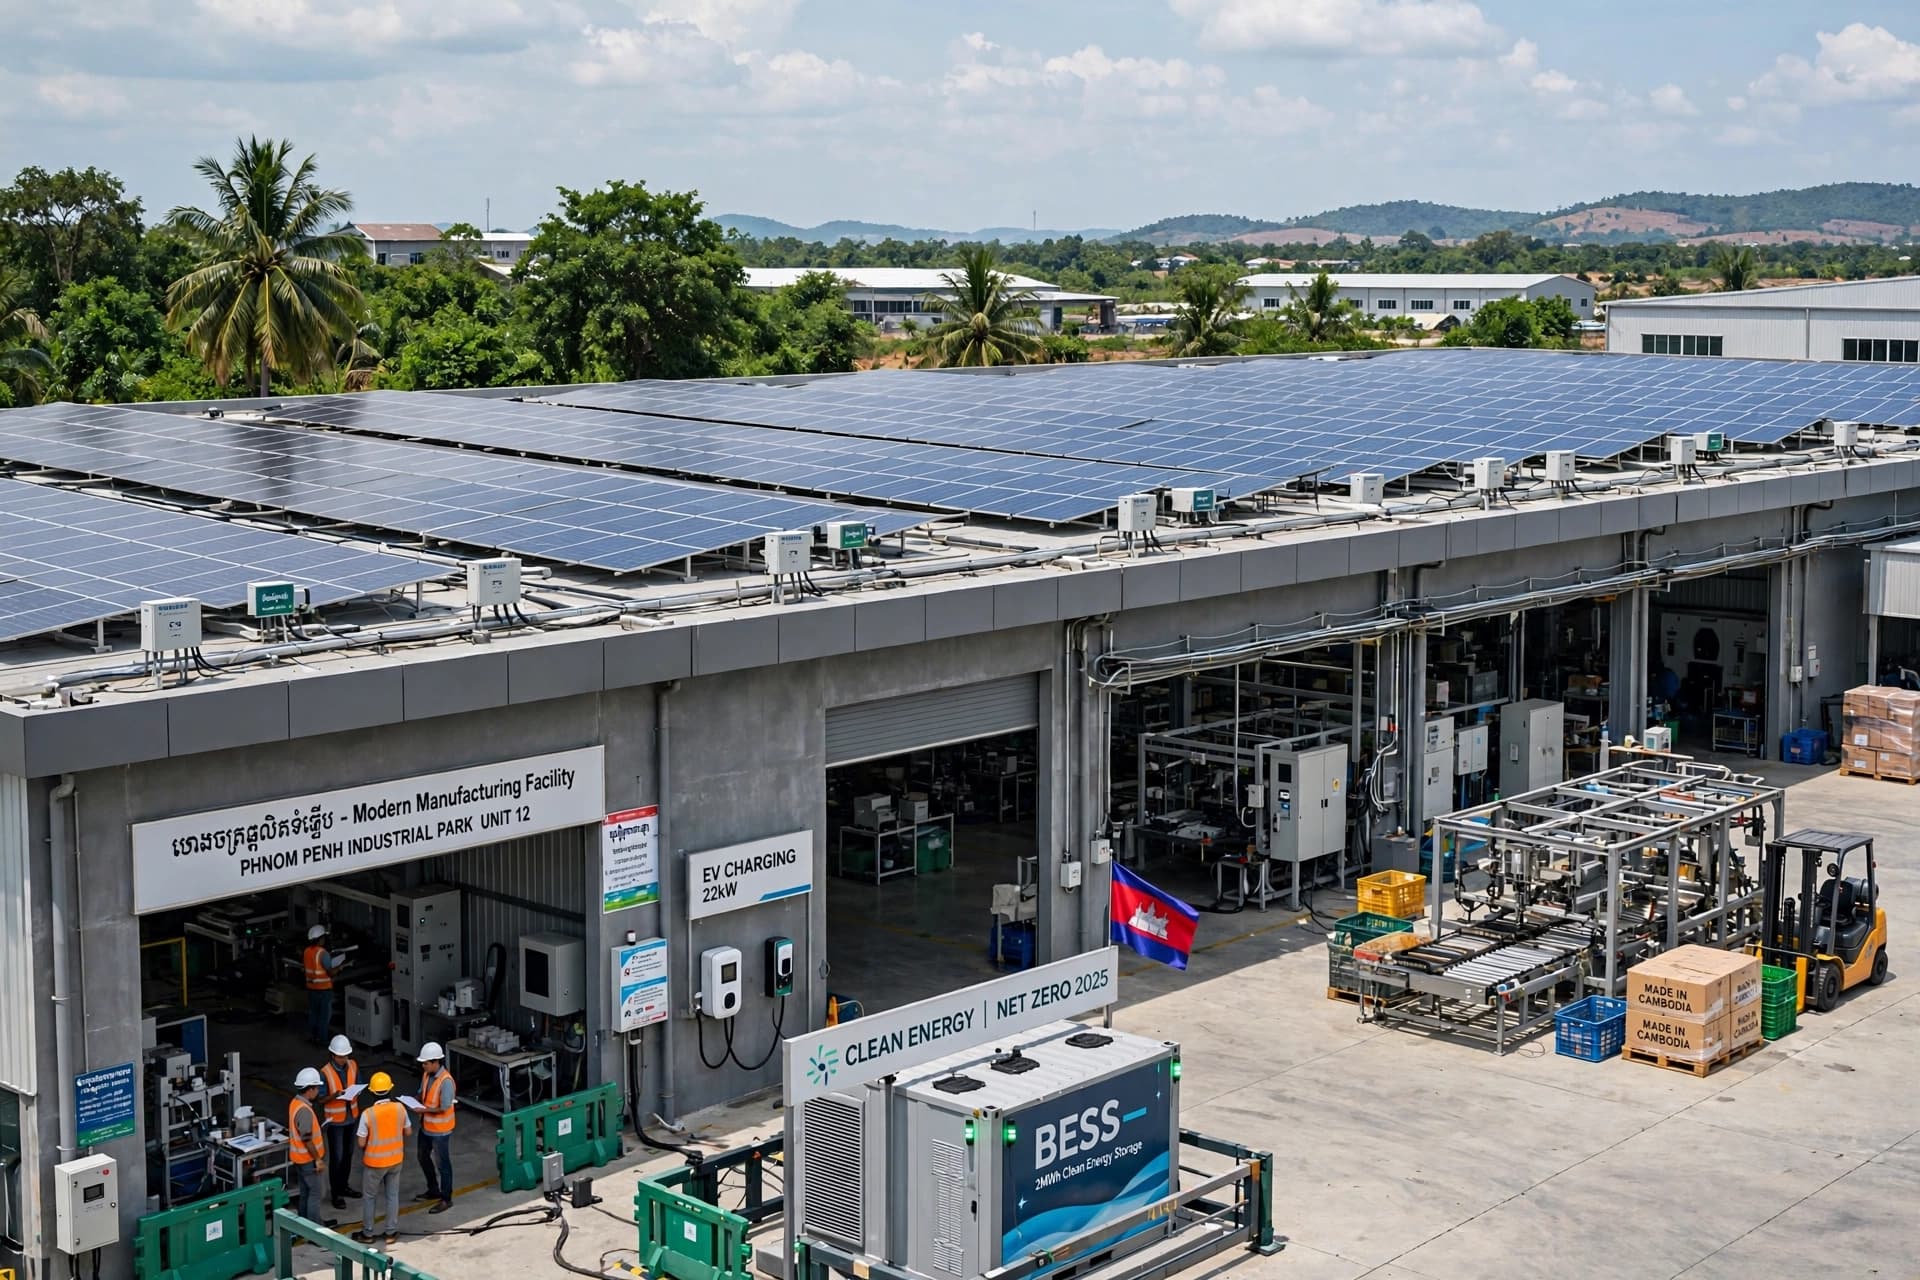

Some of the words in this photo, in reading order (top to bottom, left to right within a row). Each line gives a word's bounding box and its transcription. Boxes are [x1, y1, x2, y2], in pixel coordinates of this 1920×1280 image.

[353, 799, 411, 824] Modern
[416, 778, 521, 812] Manufacturing
[525, 767, 575, 792] Facility
[240, 850, 298, 876] PHNOM
[303, 841, 343, 864] PENH
[348, 826, 433, 855] INDUSTRIAL
[437, 816, 473, 838] PARK
[480, 809, 512, 829] UNIT
[515, 806, 530, 822] 12
[703, 864, 720, 883] EV
[724, 849, 796, 877] CHARGING
[702, 881, 737, 903] 22kW
[1638, 994, 1693, 1013] CAMBODIA
[1645, 984, 1673, 997] MADE
[1676, 990, 1687, 1001] IN
[845, 1029, 903, 1066] CLEAN
[908, 1008, 975, 1047] ENERGY
[997, 993, 1027, 1021] NET
[1031, 980, 1071, 1009] ZERO
[1074, 968, 1109, 996] 2025
[1643, 1020, 1671, 1033] MADE
[1674, 1026, 1686, 1037] IN
[1637, 1031, 1690, 1049] CAMBODIA
[1035, 1099, 1120, 1170] BESS
[1035, 1171, 1061, 1190] 2MWh
[1063, 1163, 1085, 1178] Clean
[1086, 1152, 1113, 1169] Energy
[1115, 1141, 1142, 1158] Storage
